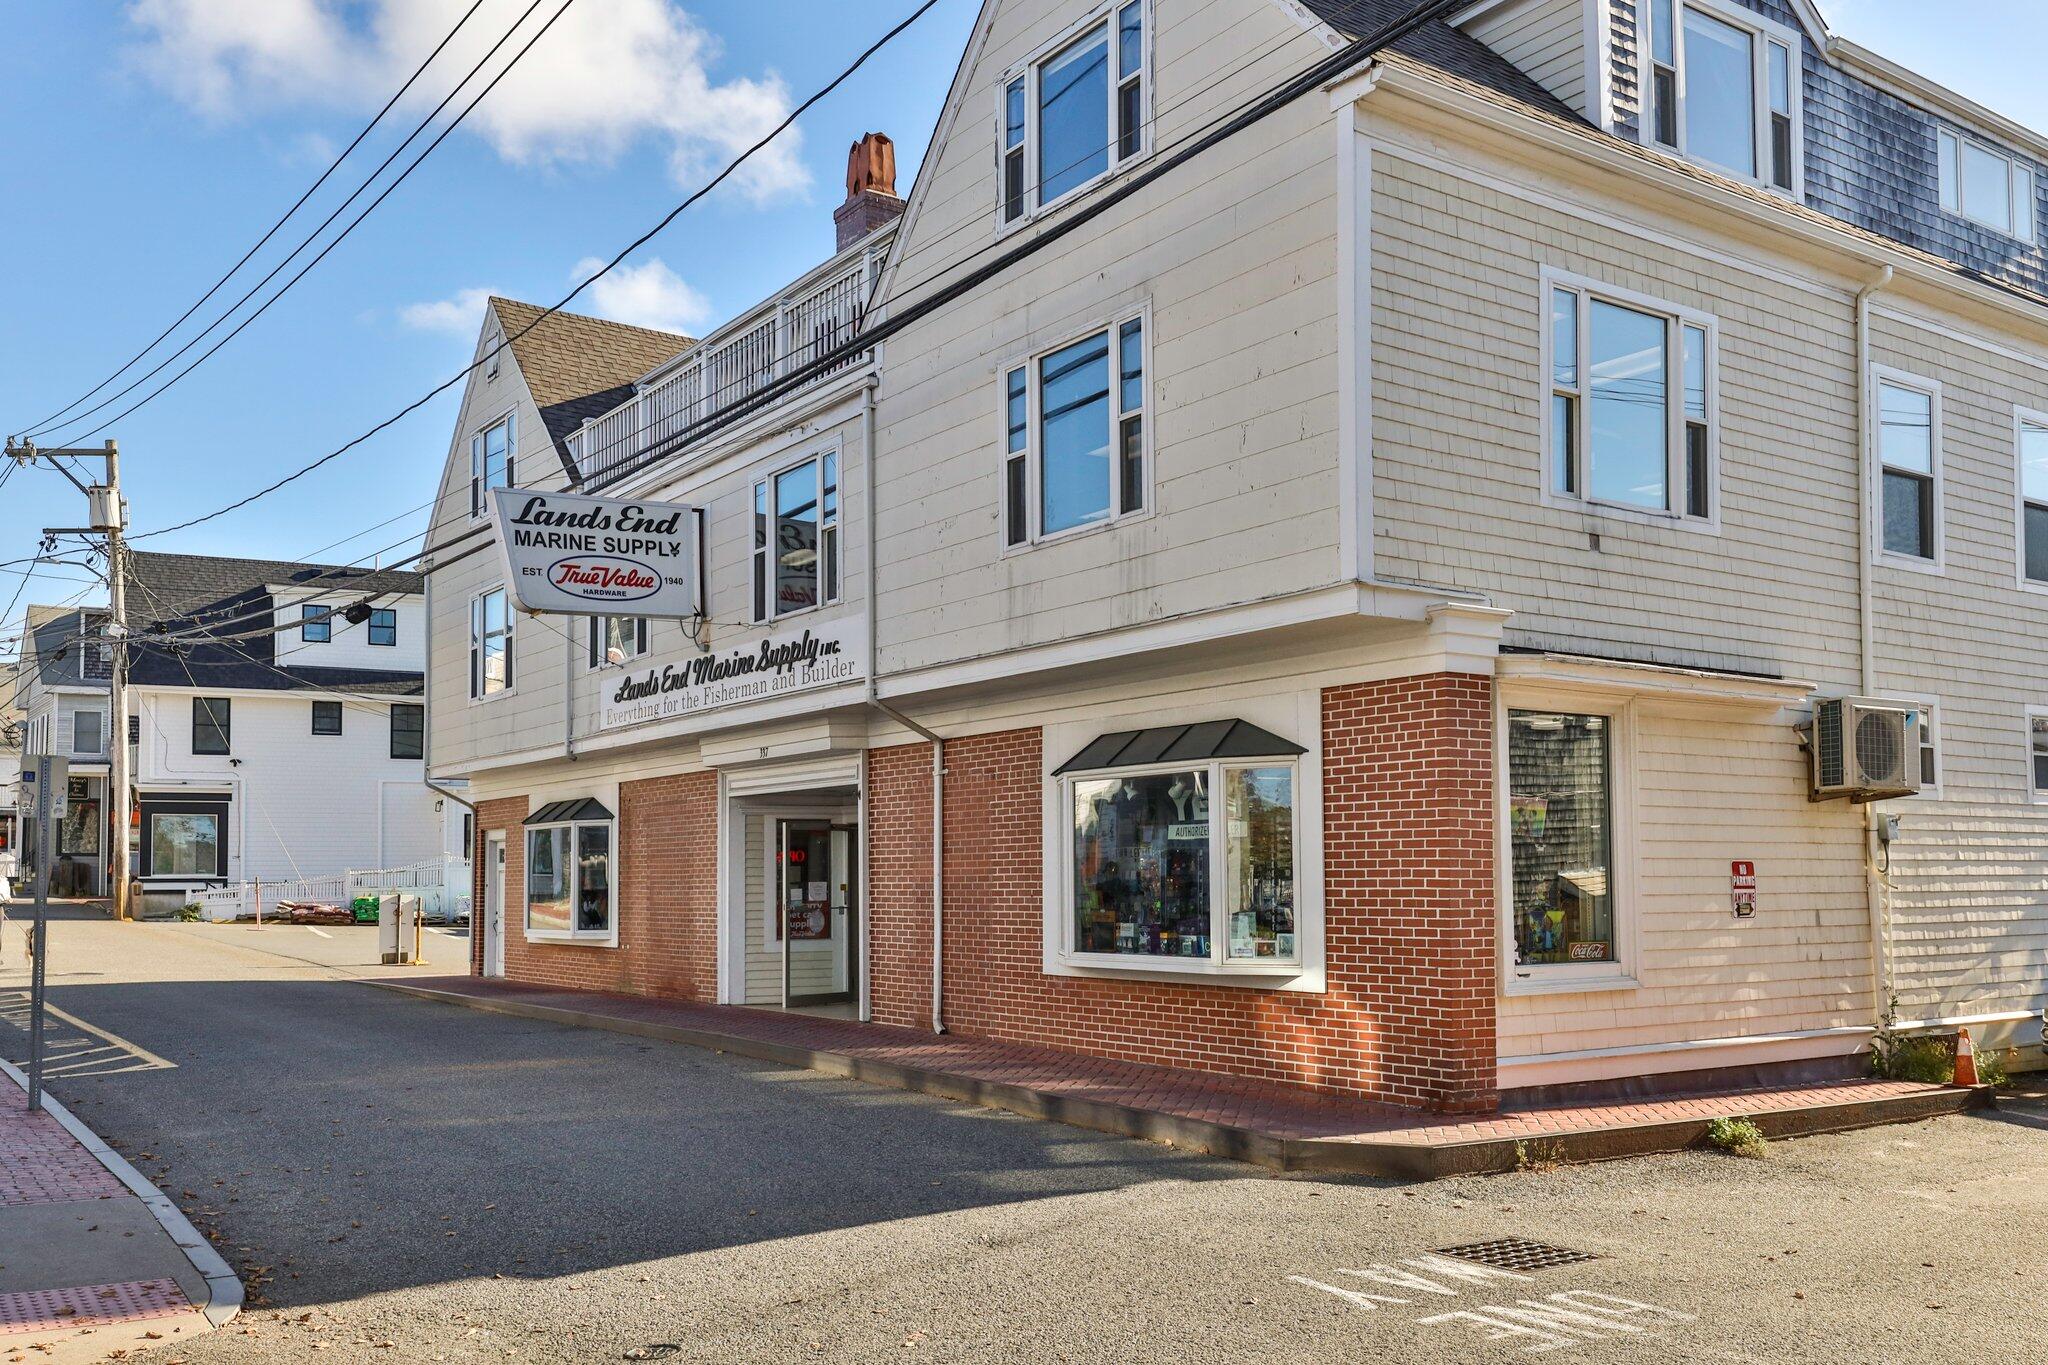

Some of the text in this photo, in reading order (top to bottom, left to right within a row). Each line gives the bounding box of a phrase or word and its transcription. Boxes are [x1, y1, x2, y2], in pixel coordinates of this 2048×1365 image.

[510, 496, 681, 535] Lands End
[514, 530, 681, 558] MARINE SUPPLY
[522, 567, 544, 577] EST.
[664, 577, 683, 586] 1940
[582, 589, 627, 598] HARDWARE
[614, 669, 659, 704] Lands
[661, 660, 692, 693] End
[693, 651, 755, 686] Marine
[755, 629, 819, 675] Supply
[607, 657, 855, 725] Everything for the Fisherman and Builder
[759, 747, 769, 759] 337
[1175, 825, 1209, 837] AUTHORIZE
